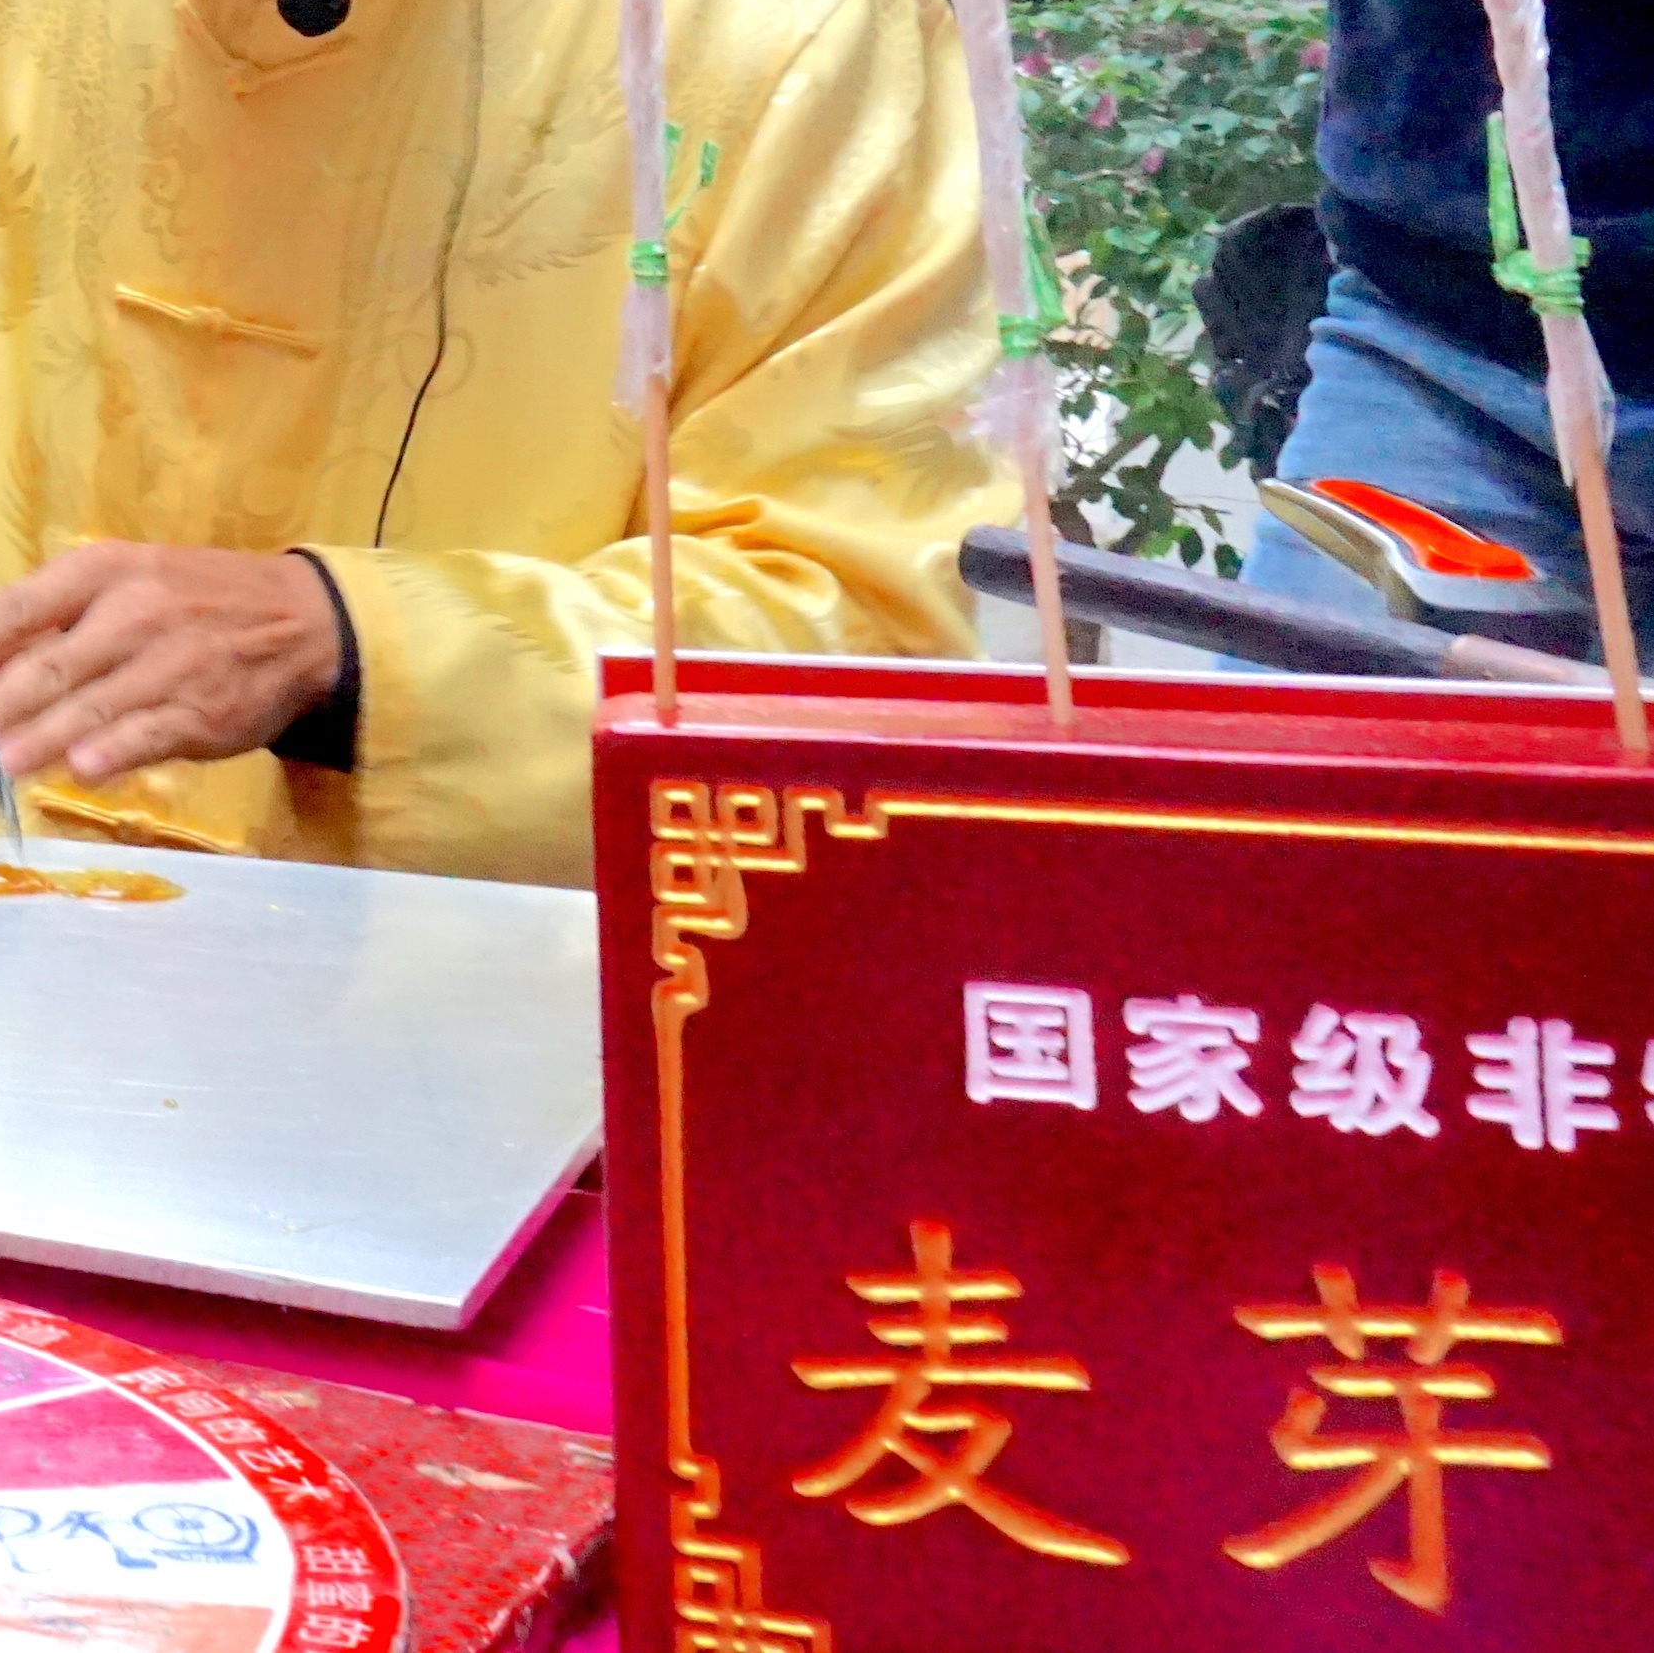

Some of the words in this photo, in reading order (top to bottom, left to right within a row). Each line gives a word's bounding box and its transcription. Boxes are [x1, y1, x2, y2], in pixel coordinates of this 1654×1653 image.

[962, 979, 1654, 1152] 国家级非
[114, 1366, 335, 1501] 民间的艺术
[790, 1218, 1566, 1615] 麦芽
[297, 1545, 376, 1653] 甜蜜的
